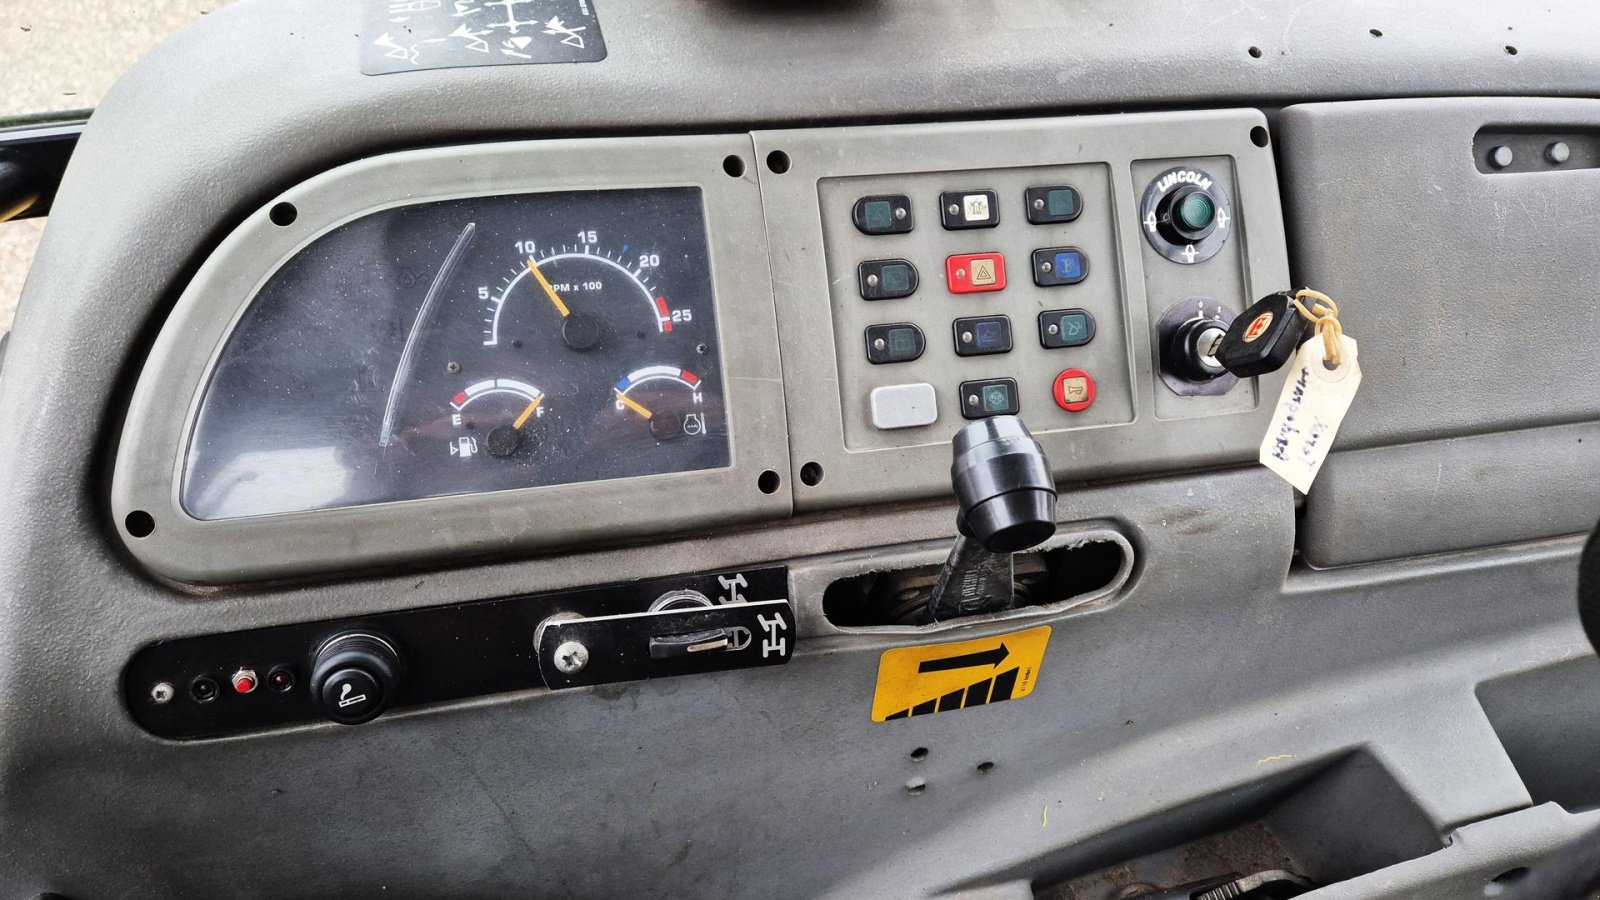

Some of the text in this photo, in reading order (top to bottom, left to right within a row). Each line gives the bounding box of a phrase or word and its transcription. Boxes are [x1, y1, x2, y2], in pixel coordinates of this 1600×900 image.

[1157, 170, 1213, 192] LINCOLN
[577, 231, 597, 244] 15
[515, 241, 536, 253] 10
[639, 254, 659, 267] 20
[582, 281, 602, 290] 100
[478, 286, 488, 299] 5
[671, 310, 692, 322] 25
[693, 391, 703, 403] H
[536, 406, 544, 418] F
[452, 414, 461, 425] E
